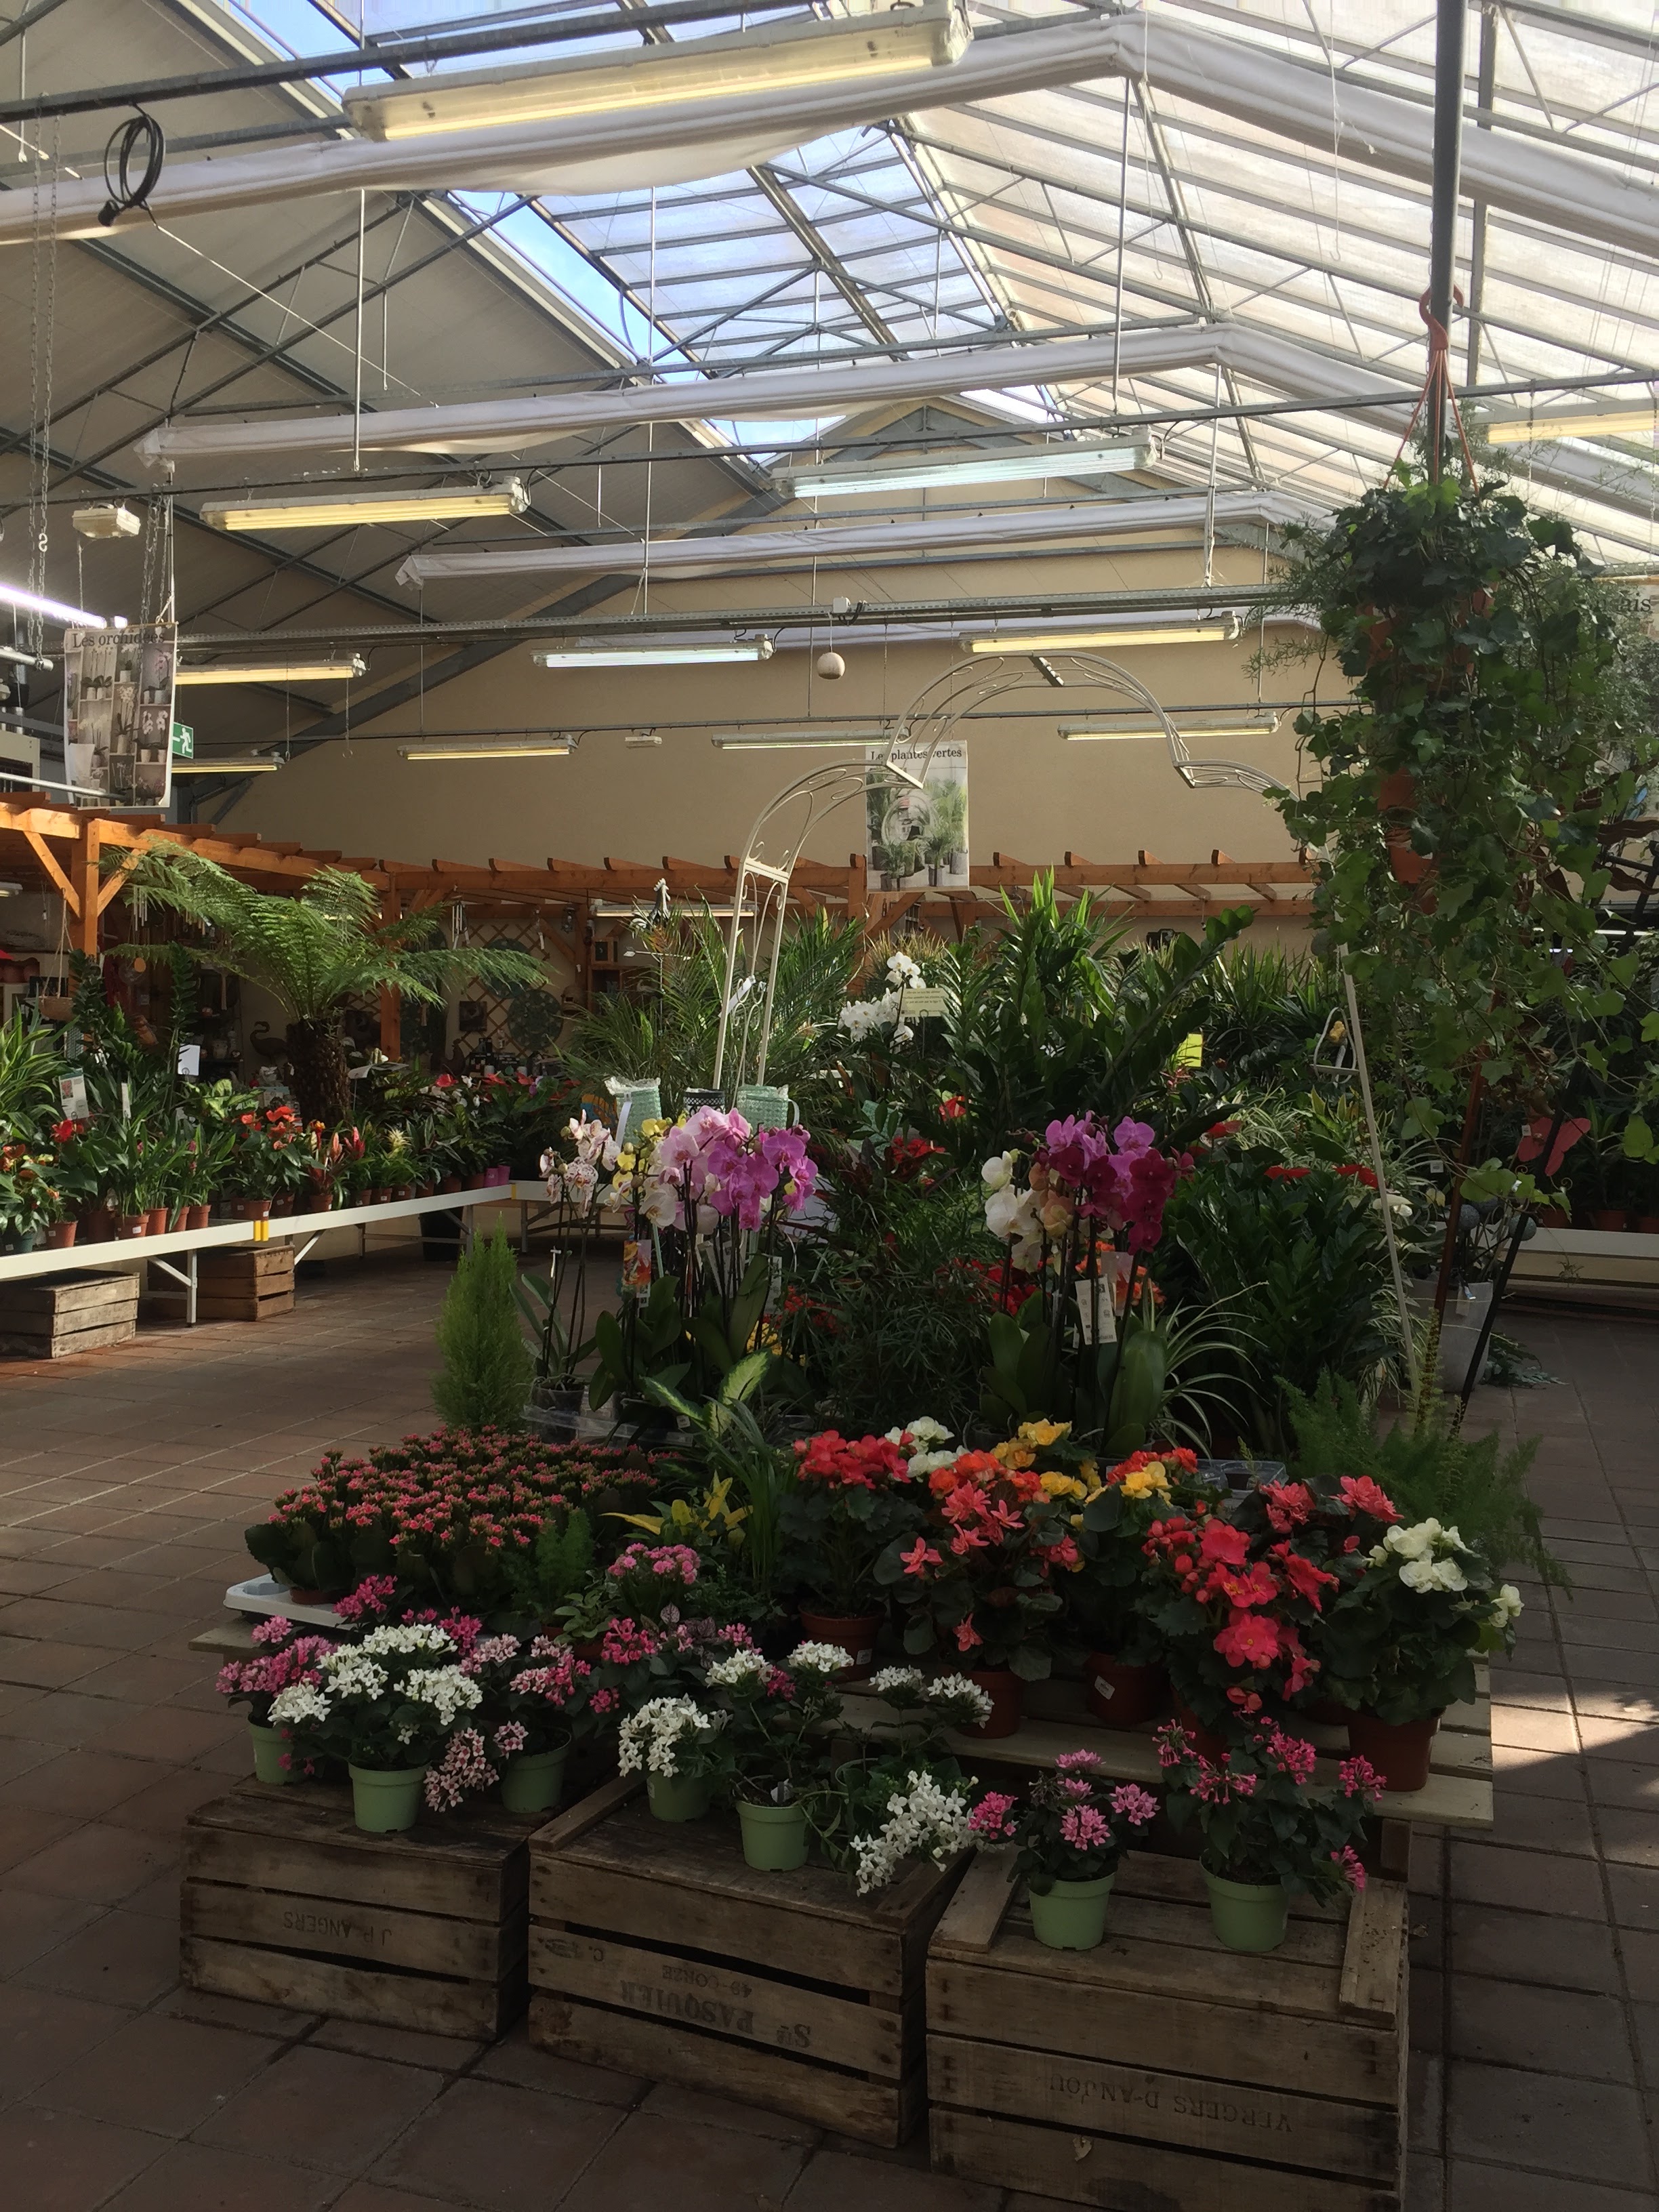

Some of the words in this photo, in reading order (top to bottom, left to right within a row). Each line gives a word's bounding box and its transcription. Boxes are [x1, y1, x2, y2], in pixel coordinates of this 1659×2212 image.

[73, 633, 95, 648] Les
[871, 751, 887, 760] Le
[891, 749, 928, 762] plantes
[283, 1911, 352, 1938] ANGERS
[620, 1980, 754, 2034] PASQUIER
[1174, 2095, 1292, 2133] VERGERS
